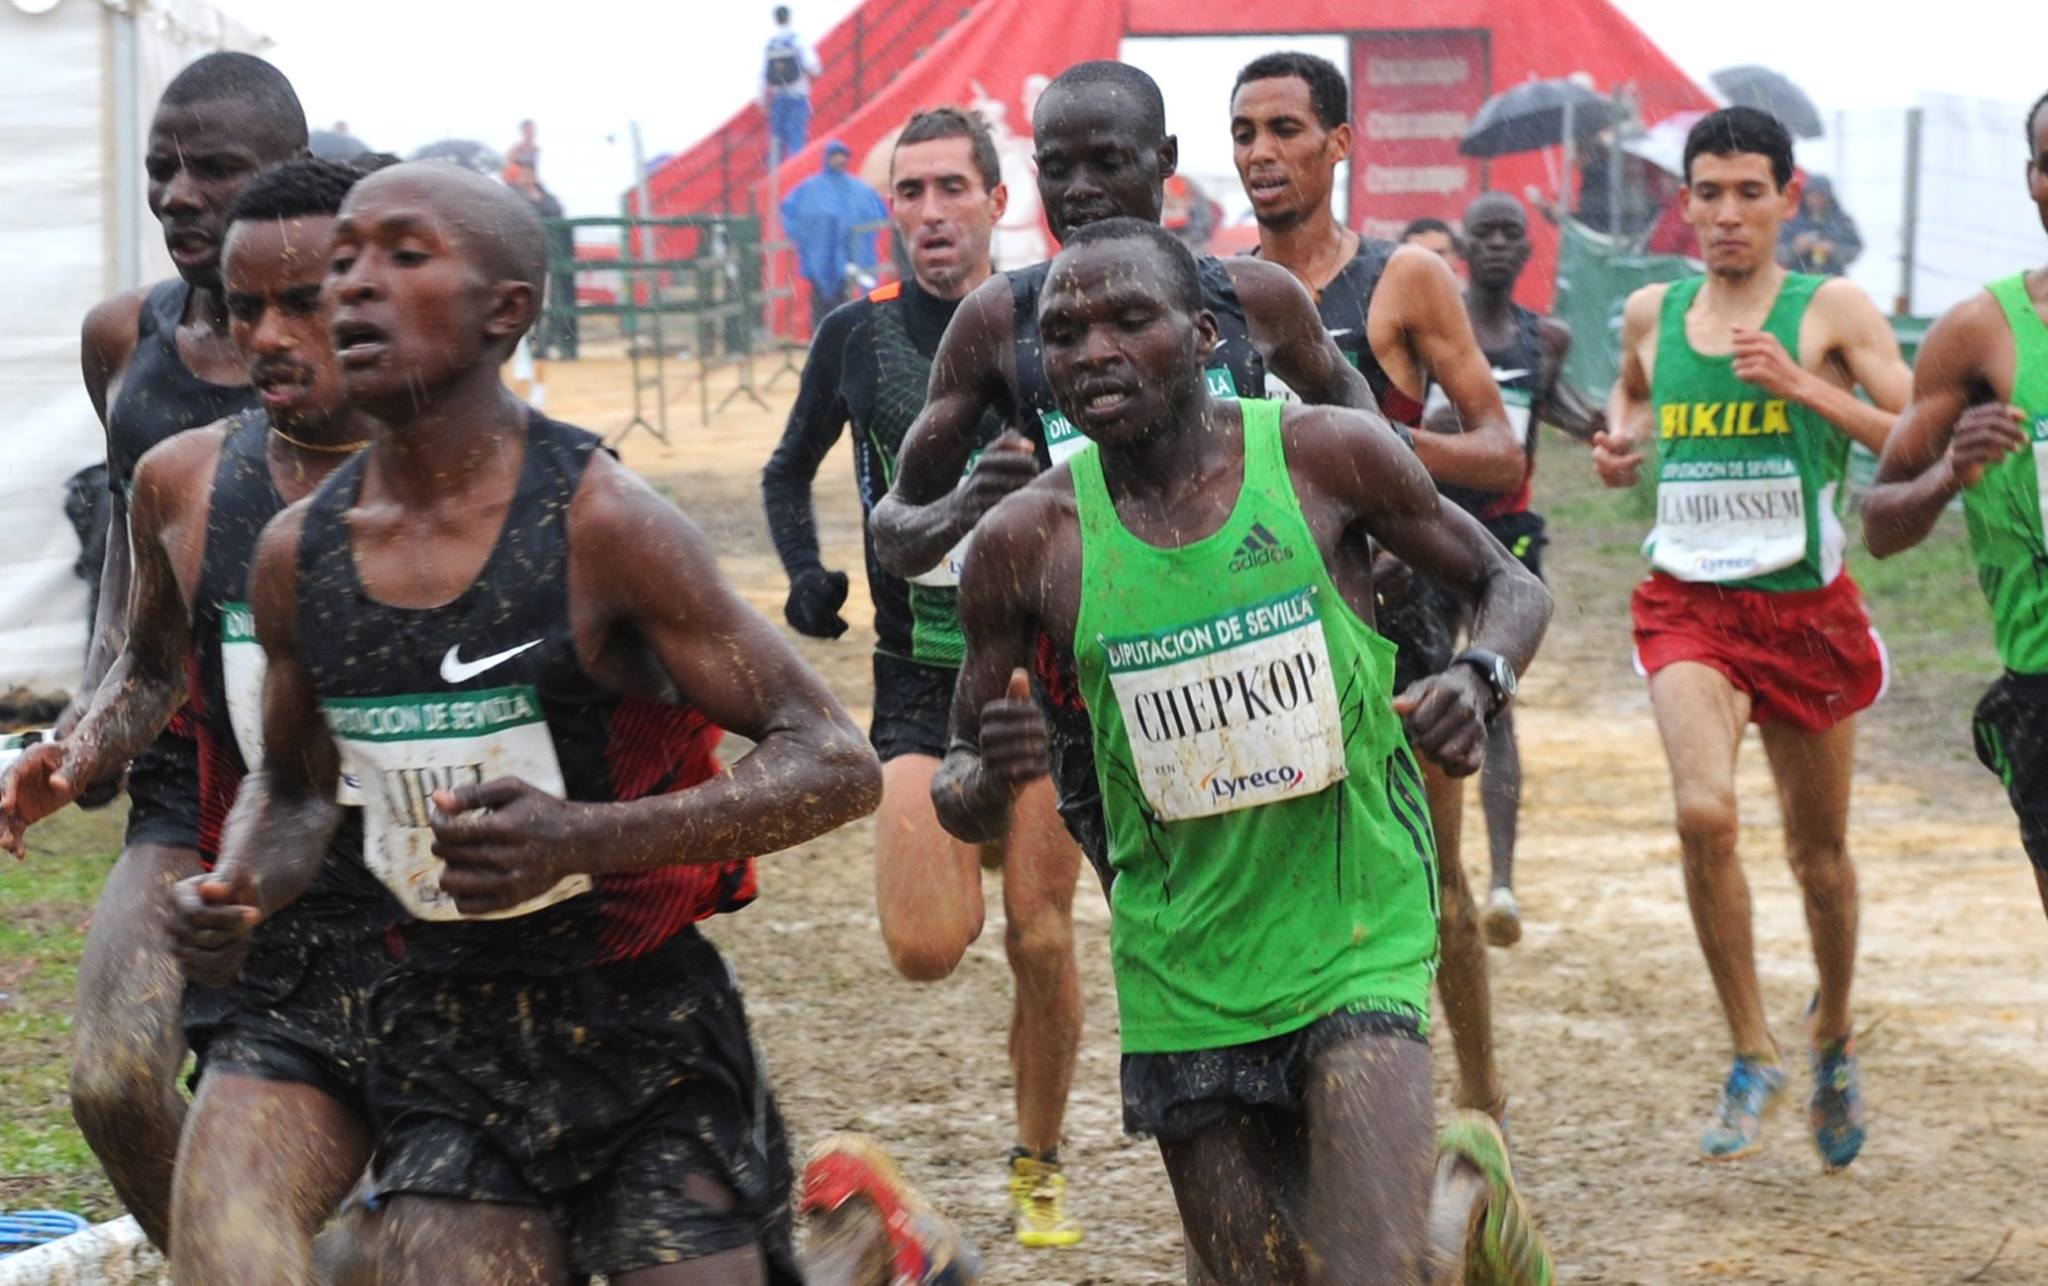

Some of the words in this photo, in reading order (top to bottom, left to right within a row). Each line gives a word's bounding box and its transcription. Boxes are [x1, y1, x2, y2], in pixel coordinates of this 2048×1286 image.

[1728, 460, 1745, 478] DE
[1661, 490, 1800, 525] LAMDASSEM
[1228, 545, 1294, 574] adidas
[1108, 624, 1213, 668] DIPUTACION
[1216, 615, 1243, 645] DE
[1245, 594, 1314, 636] SEVILLA
[1134, 650, 1317, 744] CHEPKOP
[1211, 765, 1296, 800] Lyreco
